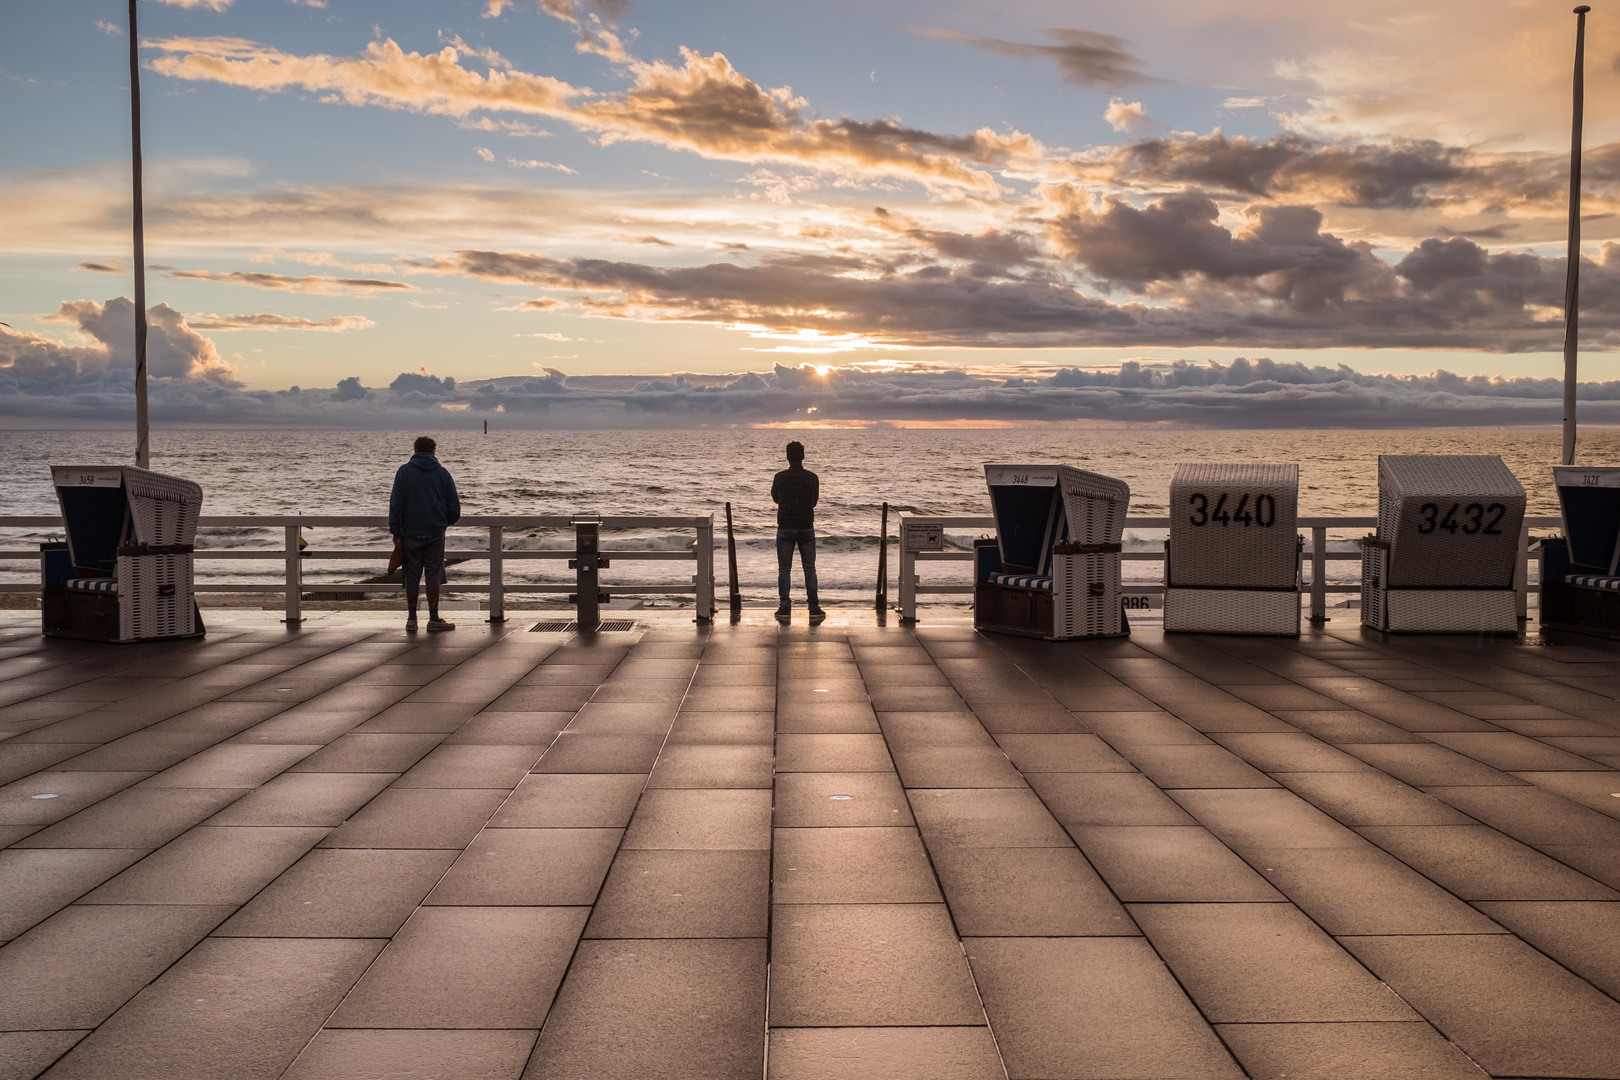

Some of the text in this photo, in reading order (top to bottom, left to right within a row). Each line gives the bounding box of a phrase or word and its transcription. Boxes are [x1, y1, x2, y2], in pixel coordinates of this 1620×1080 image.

[79, 475, 95, 485] 3458
[1012, 474, 1029, 484] 3448
[1582, 475, 1600, 485] 3426
[1189, 493, 1275, 528] 3440
[1418, 502, 1506, 534] 3432
